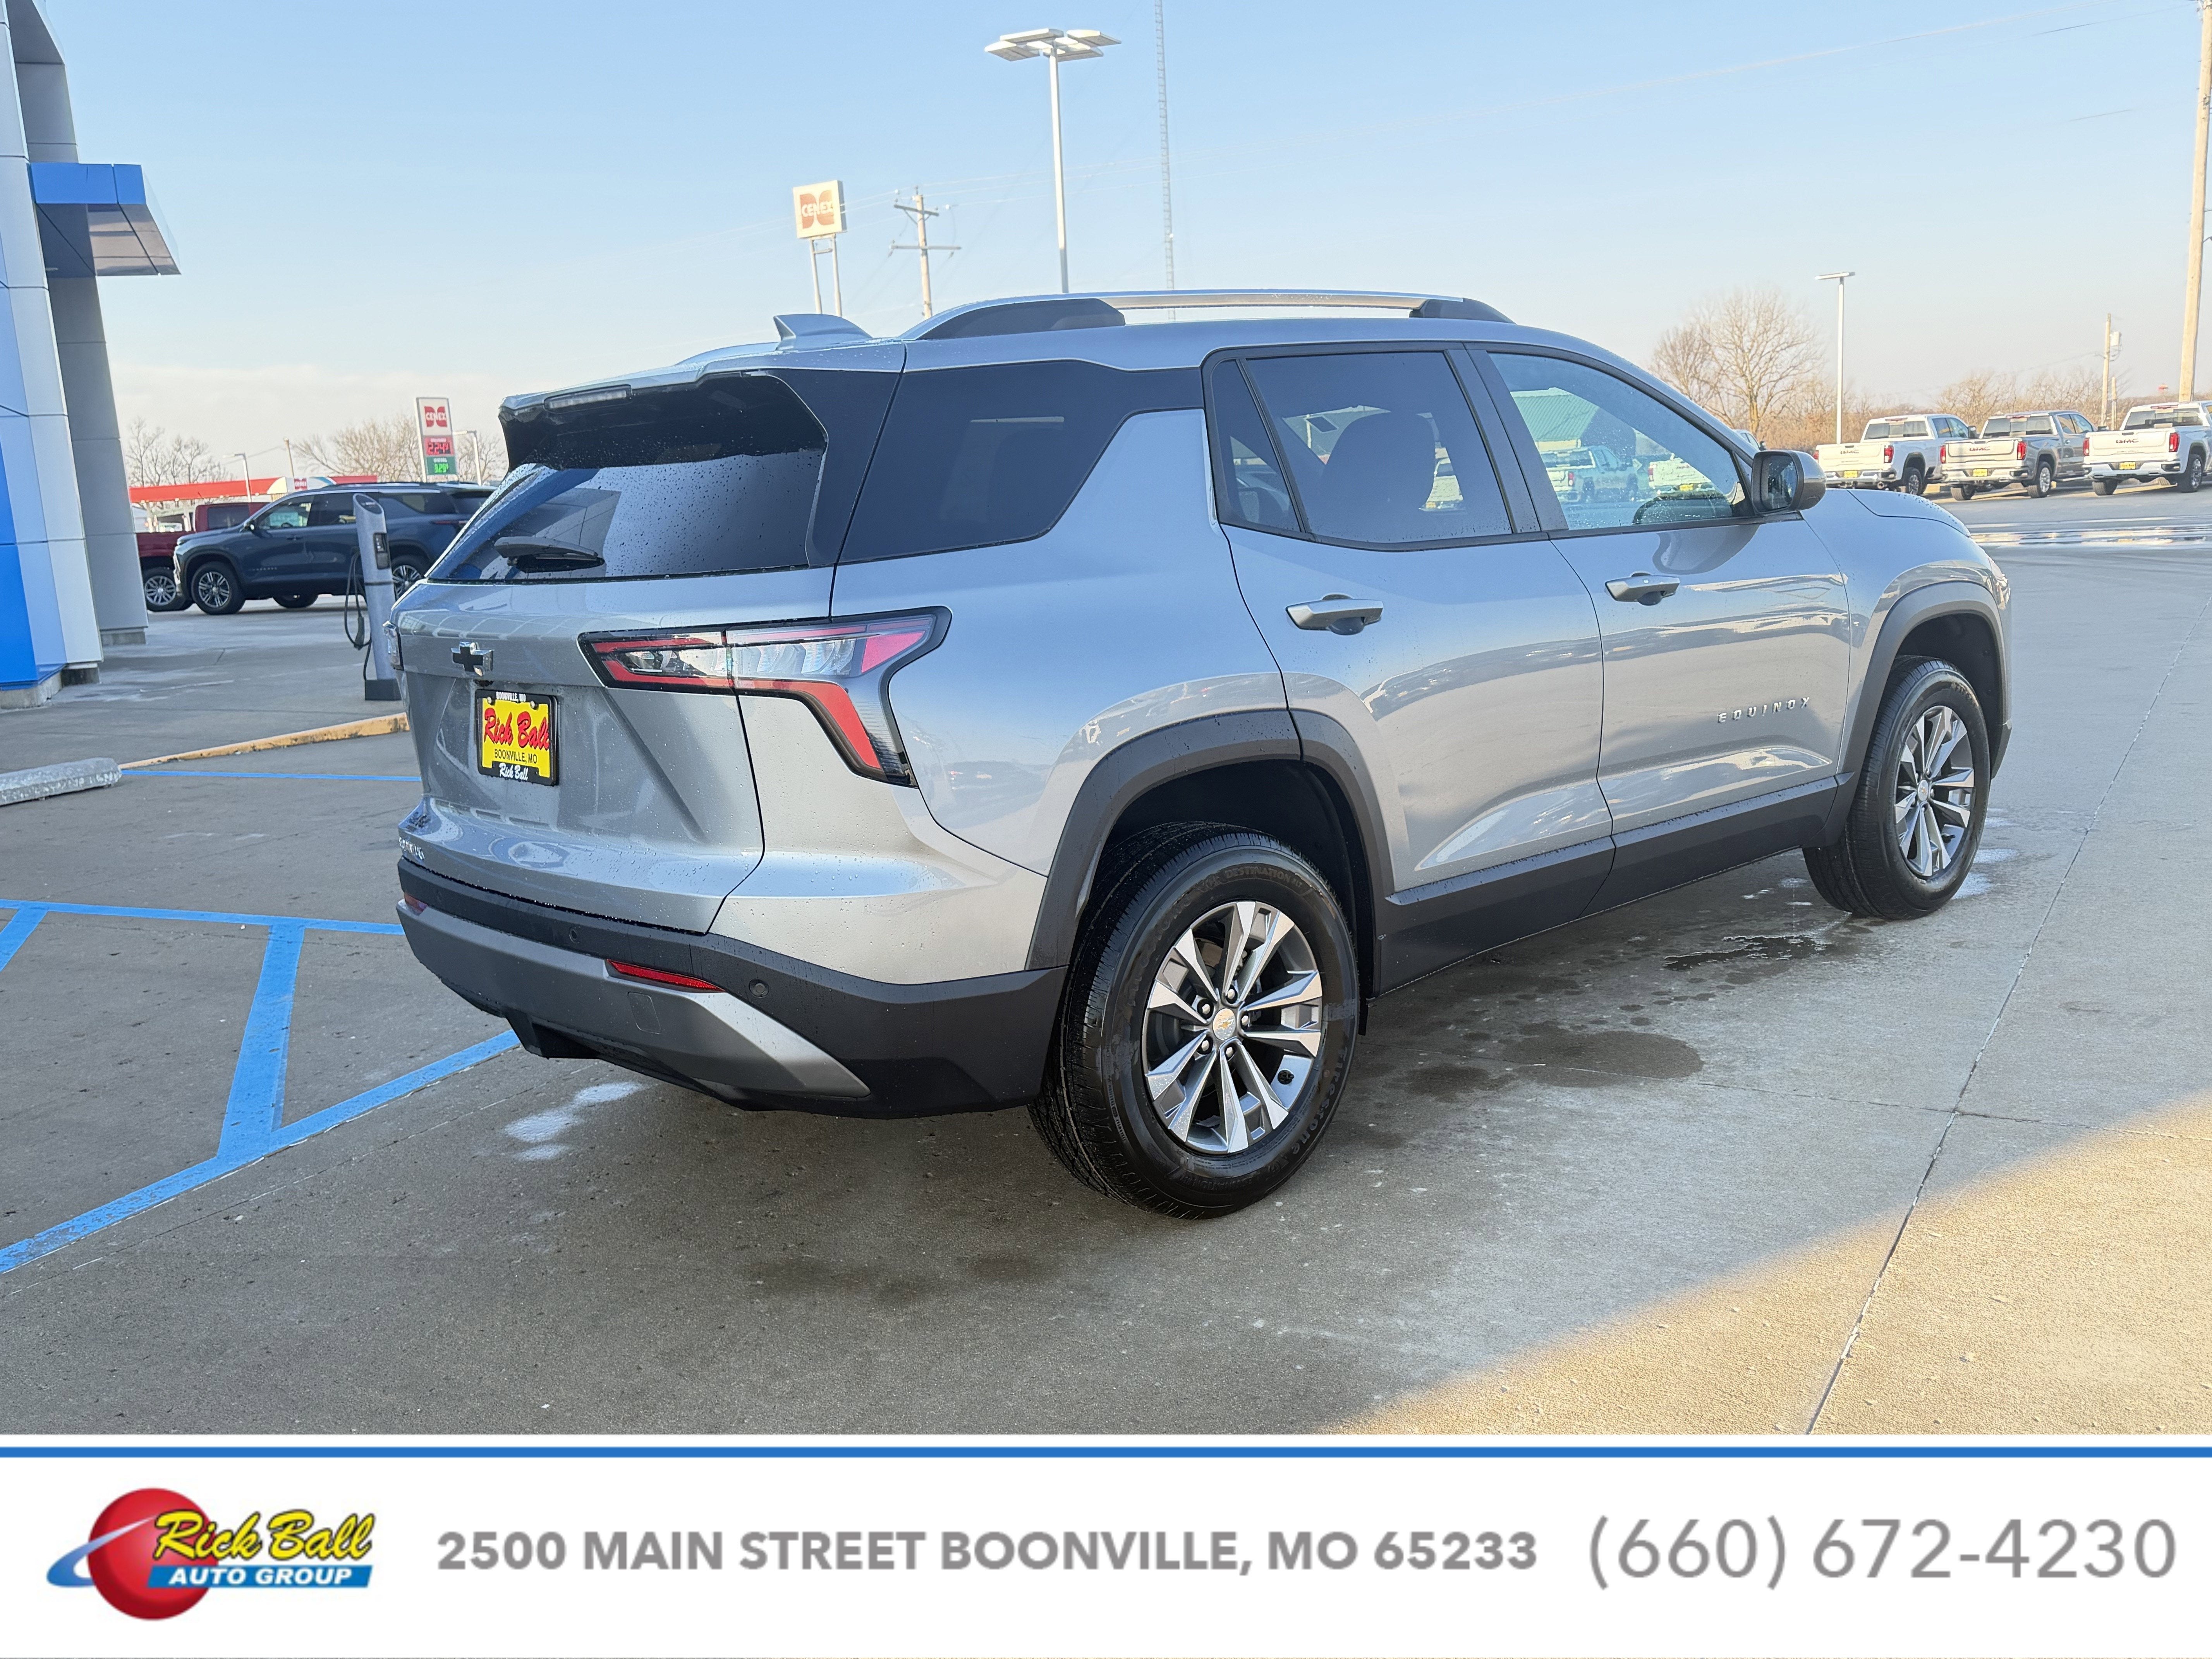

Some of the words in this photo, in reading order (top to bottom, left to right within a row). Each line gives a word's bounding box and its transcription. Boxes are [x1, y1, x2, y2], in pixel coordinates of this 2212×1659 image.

[801, 201, 833, 218] CENEX
[426, 412, 447, 421] CENEX
[1717, 697, 1810, 723] EQUINOX
[484, 708, 514, 746] Rick
[517, 711, 550, 750] Ball
[495, 749, 527, 764] BOONVILLE,
[528, 753, 538, 764] MO
[499, 763, 514, 779] Rick
[514, 764, 529, 781] Ball
